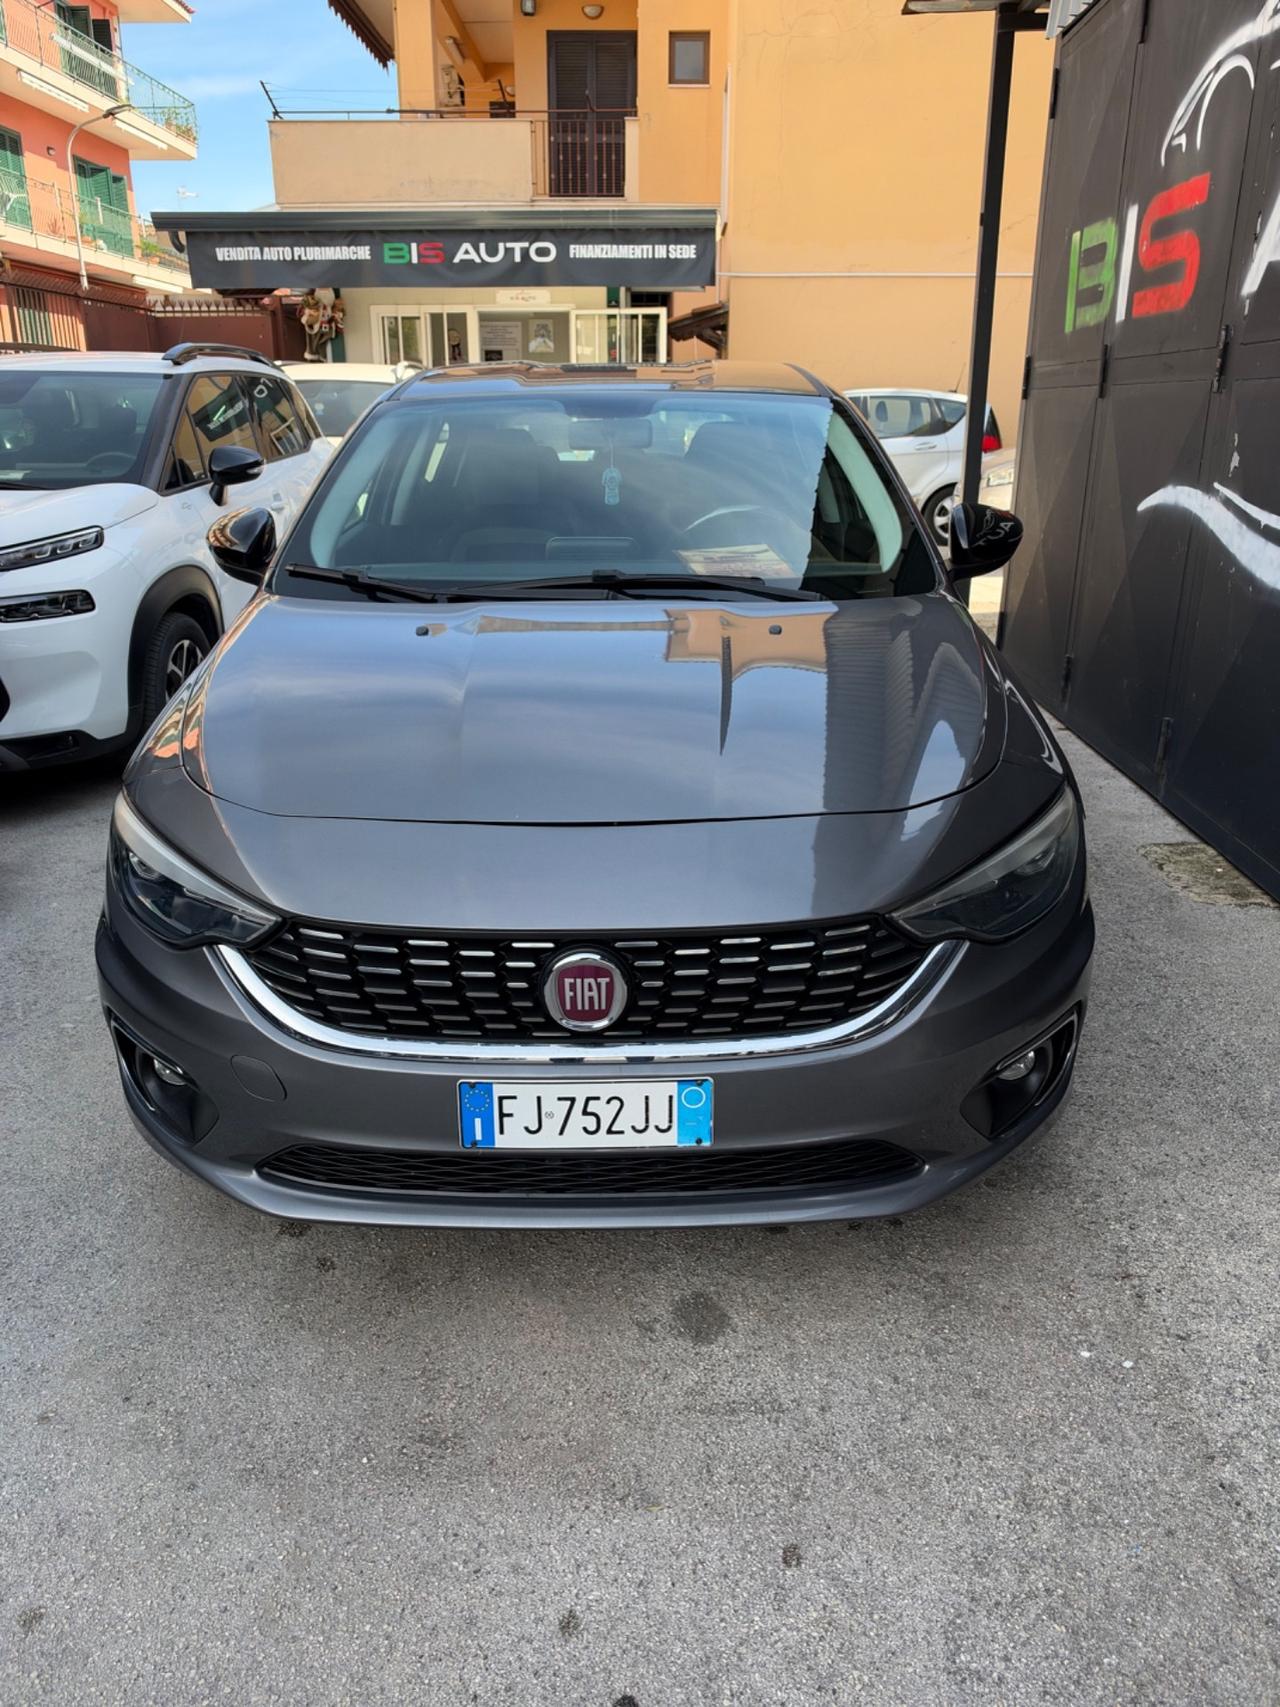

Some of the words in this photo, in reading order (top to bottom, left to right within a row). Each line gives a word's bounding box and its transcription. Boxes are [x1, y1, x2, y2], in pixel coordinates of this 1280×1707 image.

[215, 246, 261, 261] VENDITA
[262, 246, 293, 261] AUTO
[293, 245, 372, 261] PLURIMARCHE
[383, 241, 445, 264] BIS
[452, 241, 557, 263] AUTO
[569, 244, 653, 259] FINANZIAMENTI
[654, 244, 667, 259] IN
[668, 244, 697, 259] SEDE
[1064, 171, 1211, 334] BIS
[563, 977, 611, 1011] FIAT
